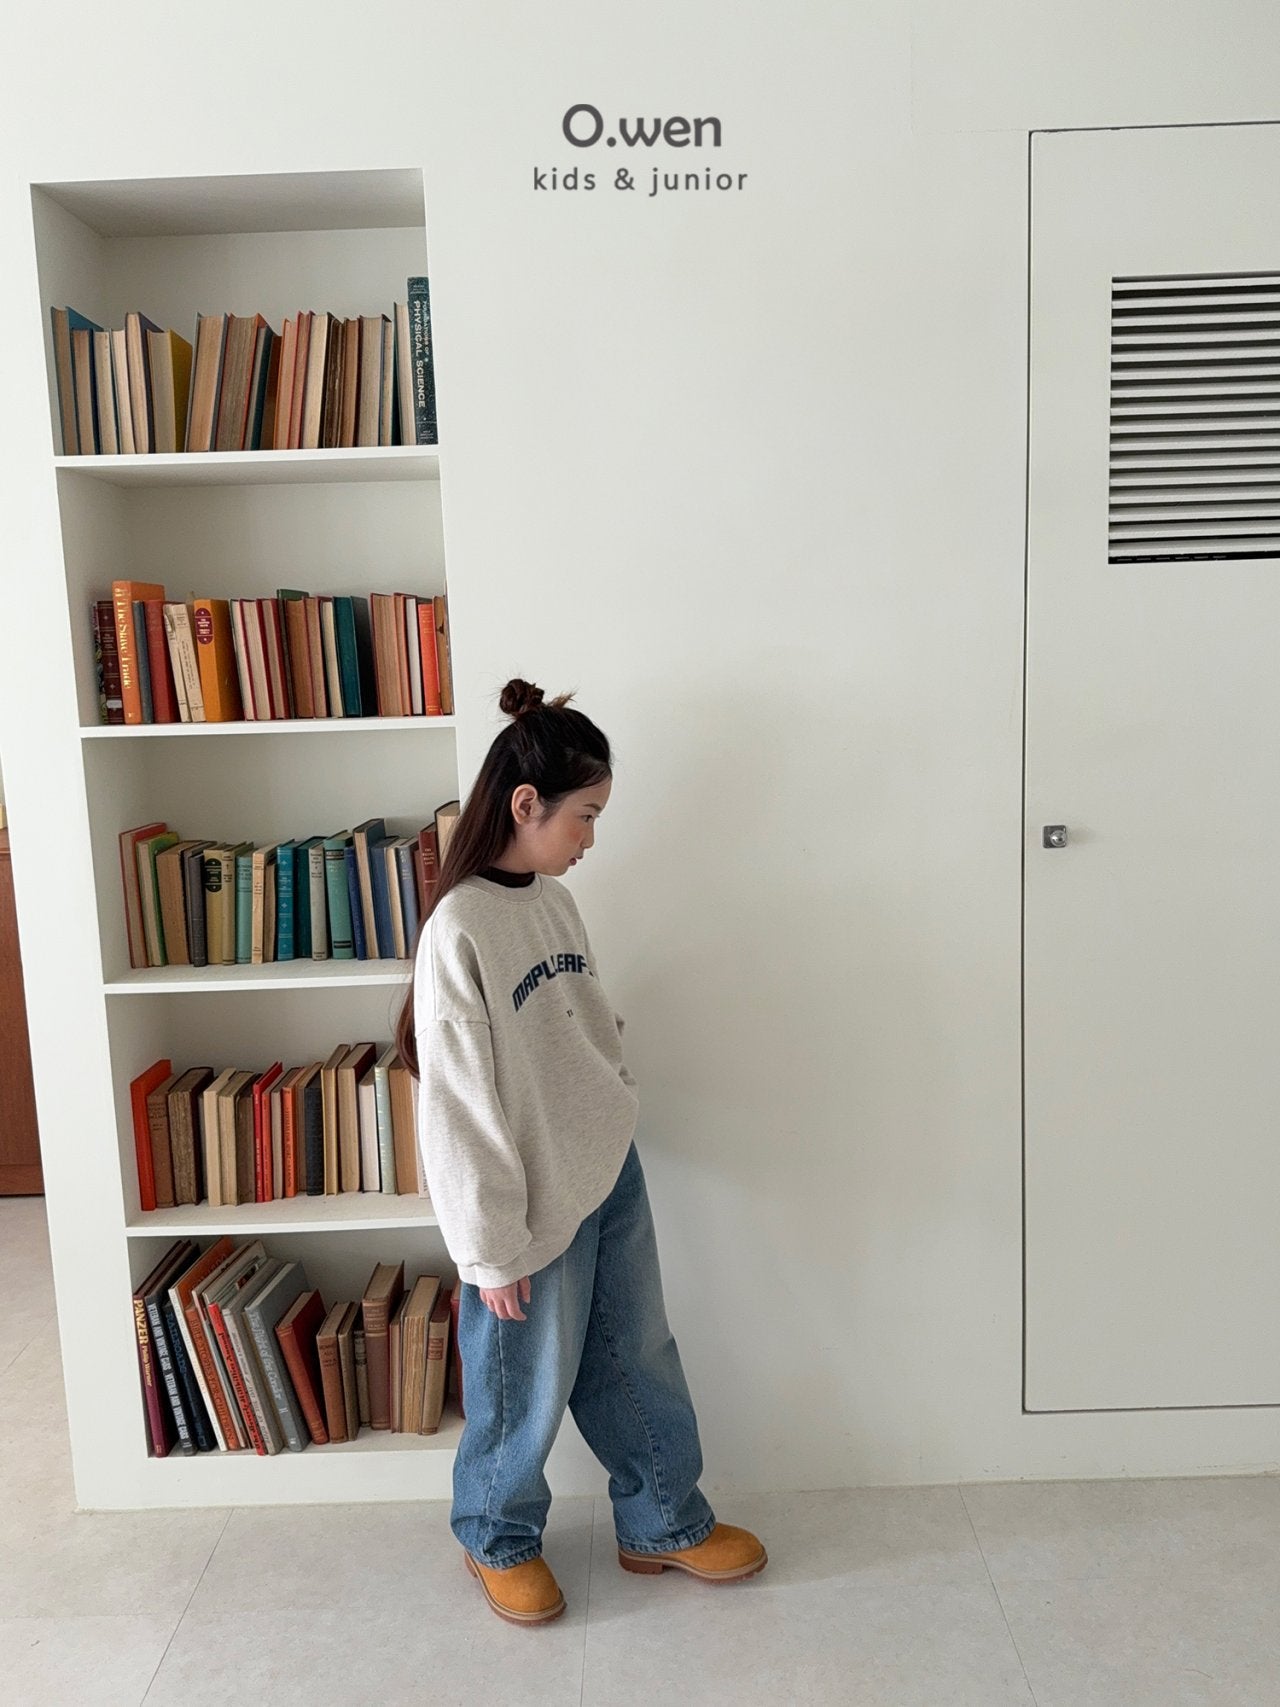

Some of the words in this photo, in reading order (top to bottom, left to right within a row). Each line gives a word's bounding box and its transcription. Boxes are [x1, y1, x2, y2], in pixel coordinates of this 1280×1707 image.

[413, 300, 423, 357] PHYSICAL
[415, 359, 426, 408] SCIENCE
[147, 1303, 161, 1327] VETERAN
[134, 1299, 149, 1345] PANZER
[144, 1363, 153, 1387] Warner
[153, 1326, 164, 1339] AND
[166, 1311, 187, 1376] RAILROADS
[156, 1337, 169, 1358] VINTAGE
[161, 1356, 172, 1371] CARS
[164, 1373, 179, 1396] VETERAN
[169, 1395, 181, 1407] AND
[173, 1405, 187, 1427] VINTAGE
[179, 1425, 190, 1440] CARS
